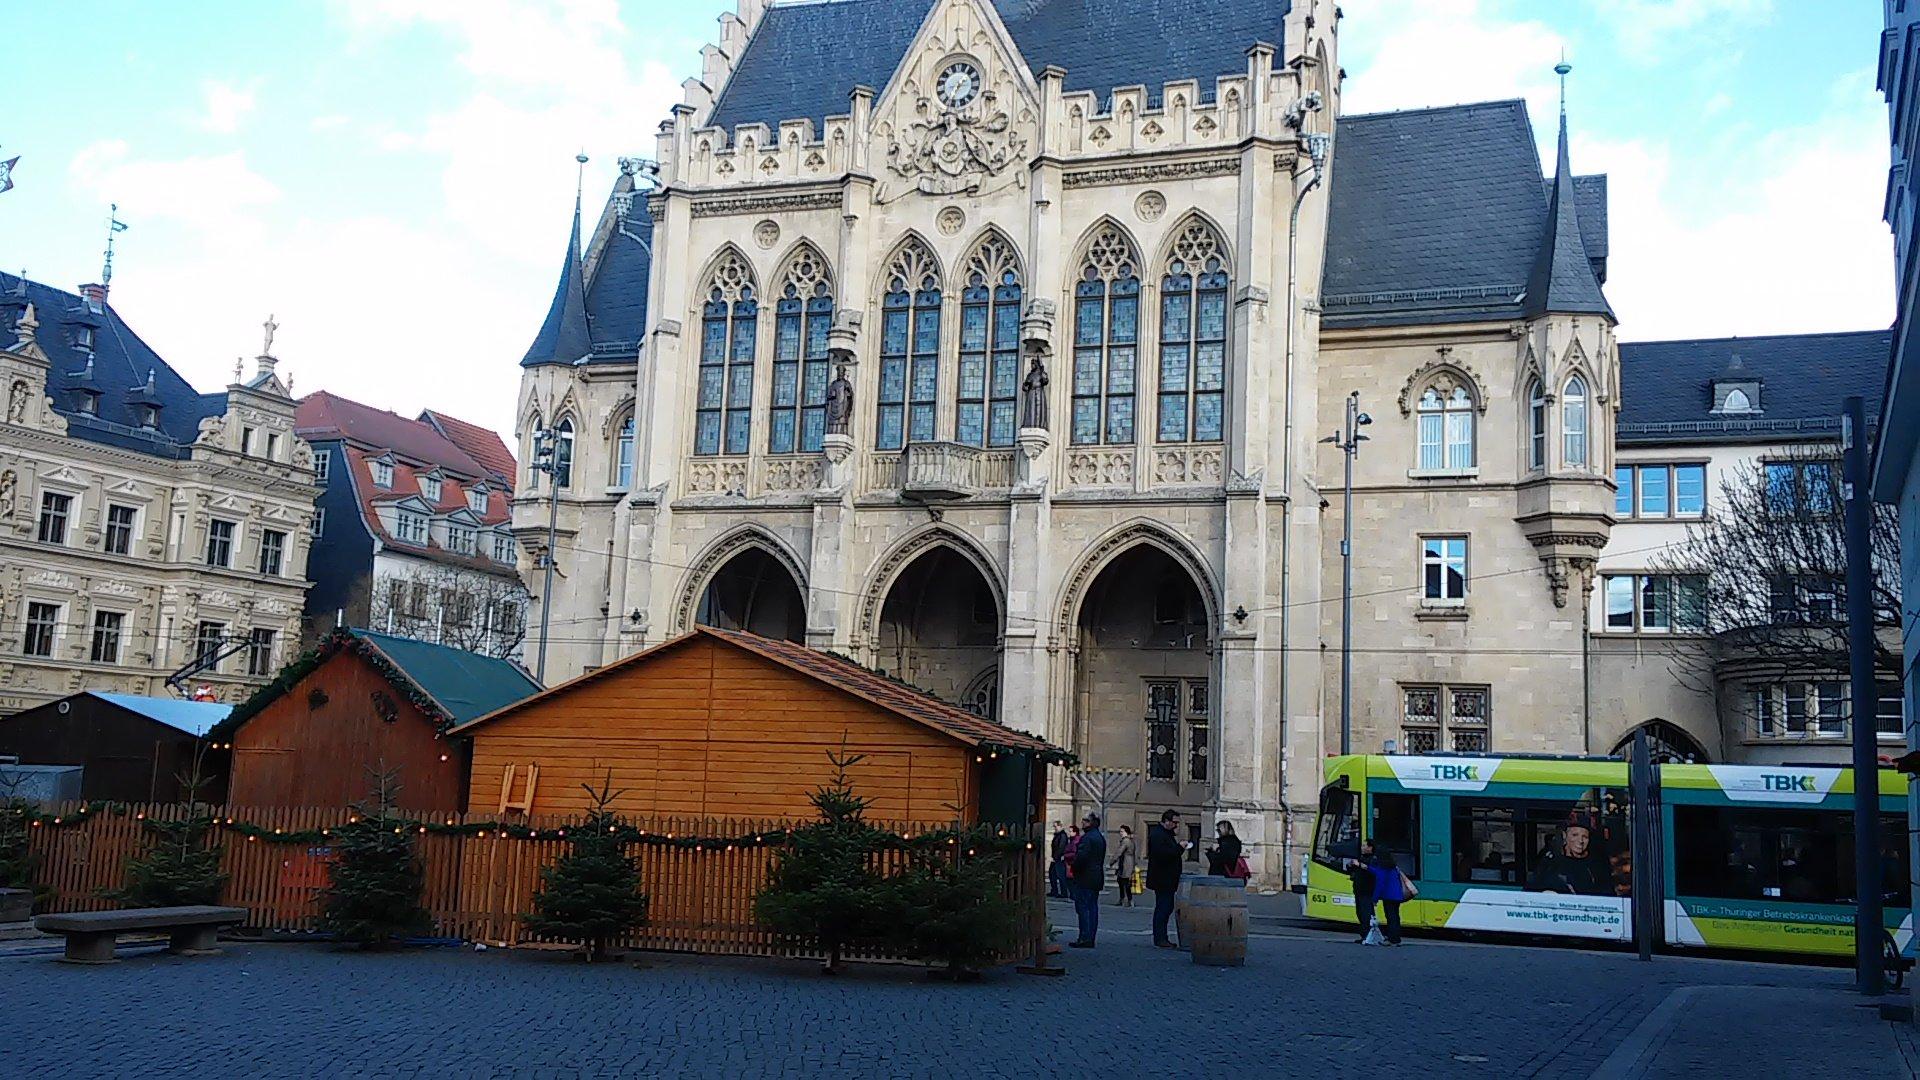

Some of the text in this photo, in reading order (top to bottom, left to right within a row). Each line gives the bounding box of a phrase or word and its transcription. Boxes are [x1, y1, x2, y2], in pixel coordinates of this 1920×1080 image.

[1431, 764, 1471, 780] TBK
[1760, 774, 1807, 791] TBK
[1691, 904, 1710, 914] TBK
[1783, 925, 1836, 936] Gesundheit
